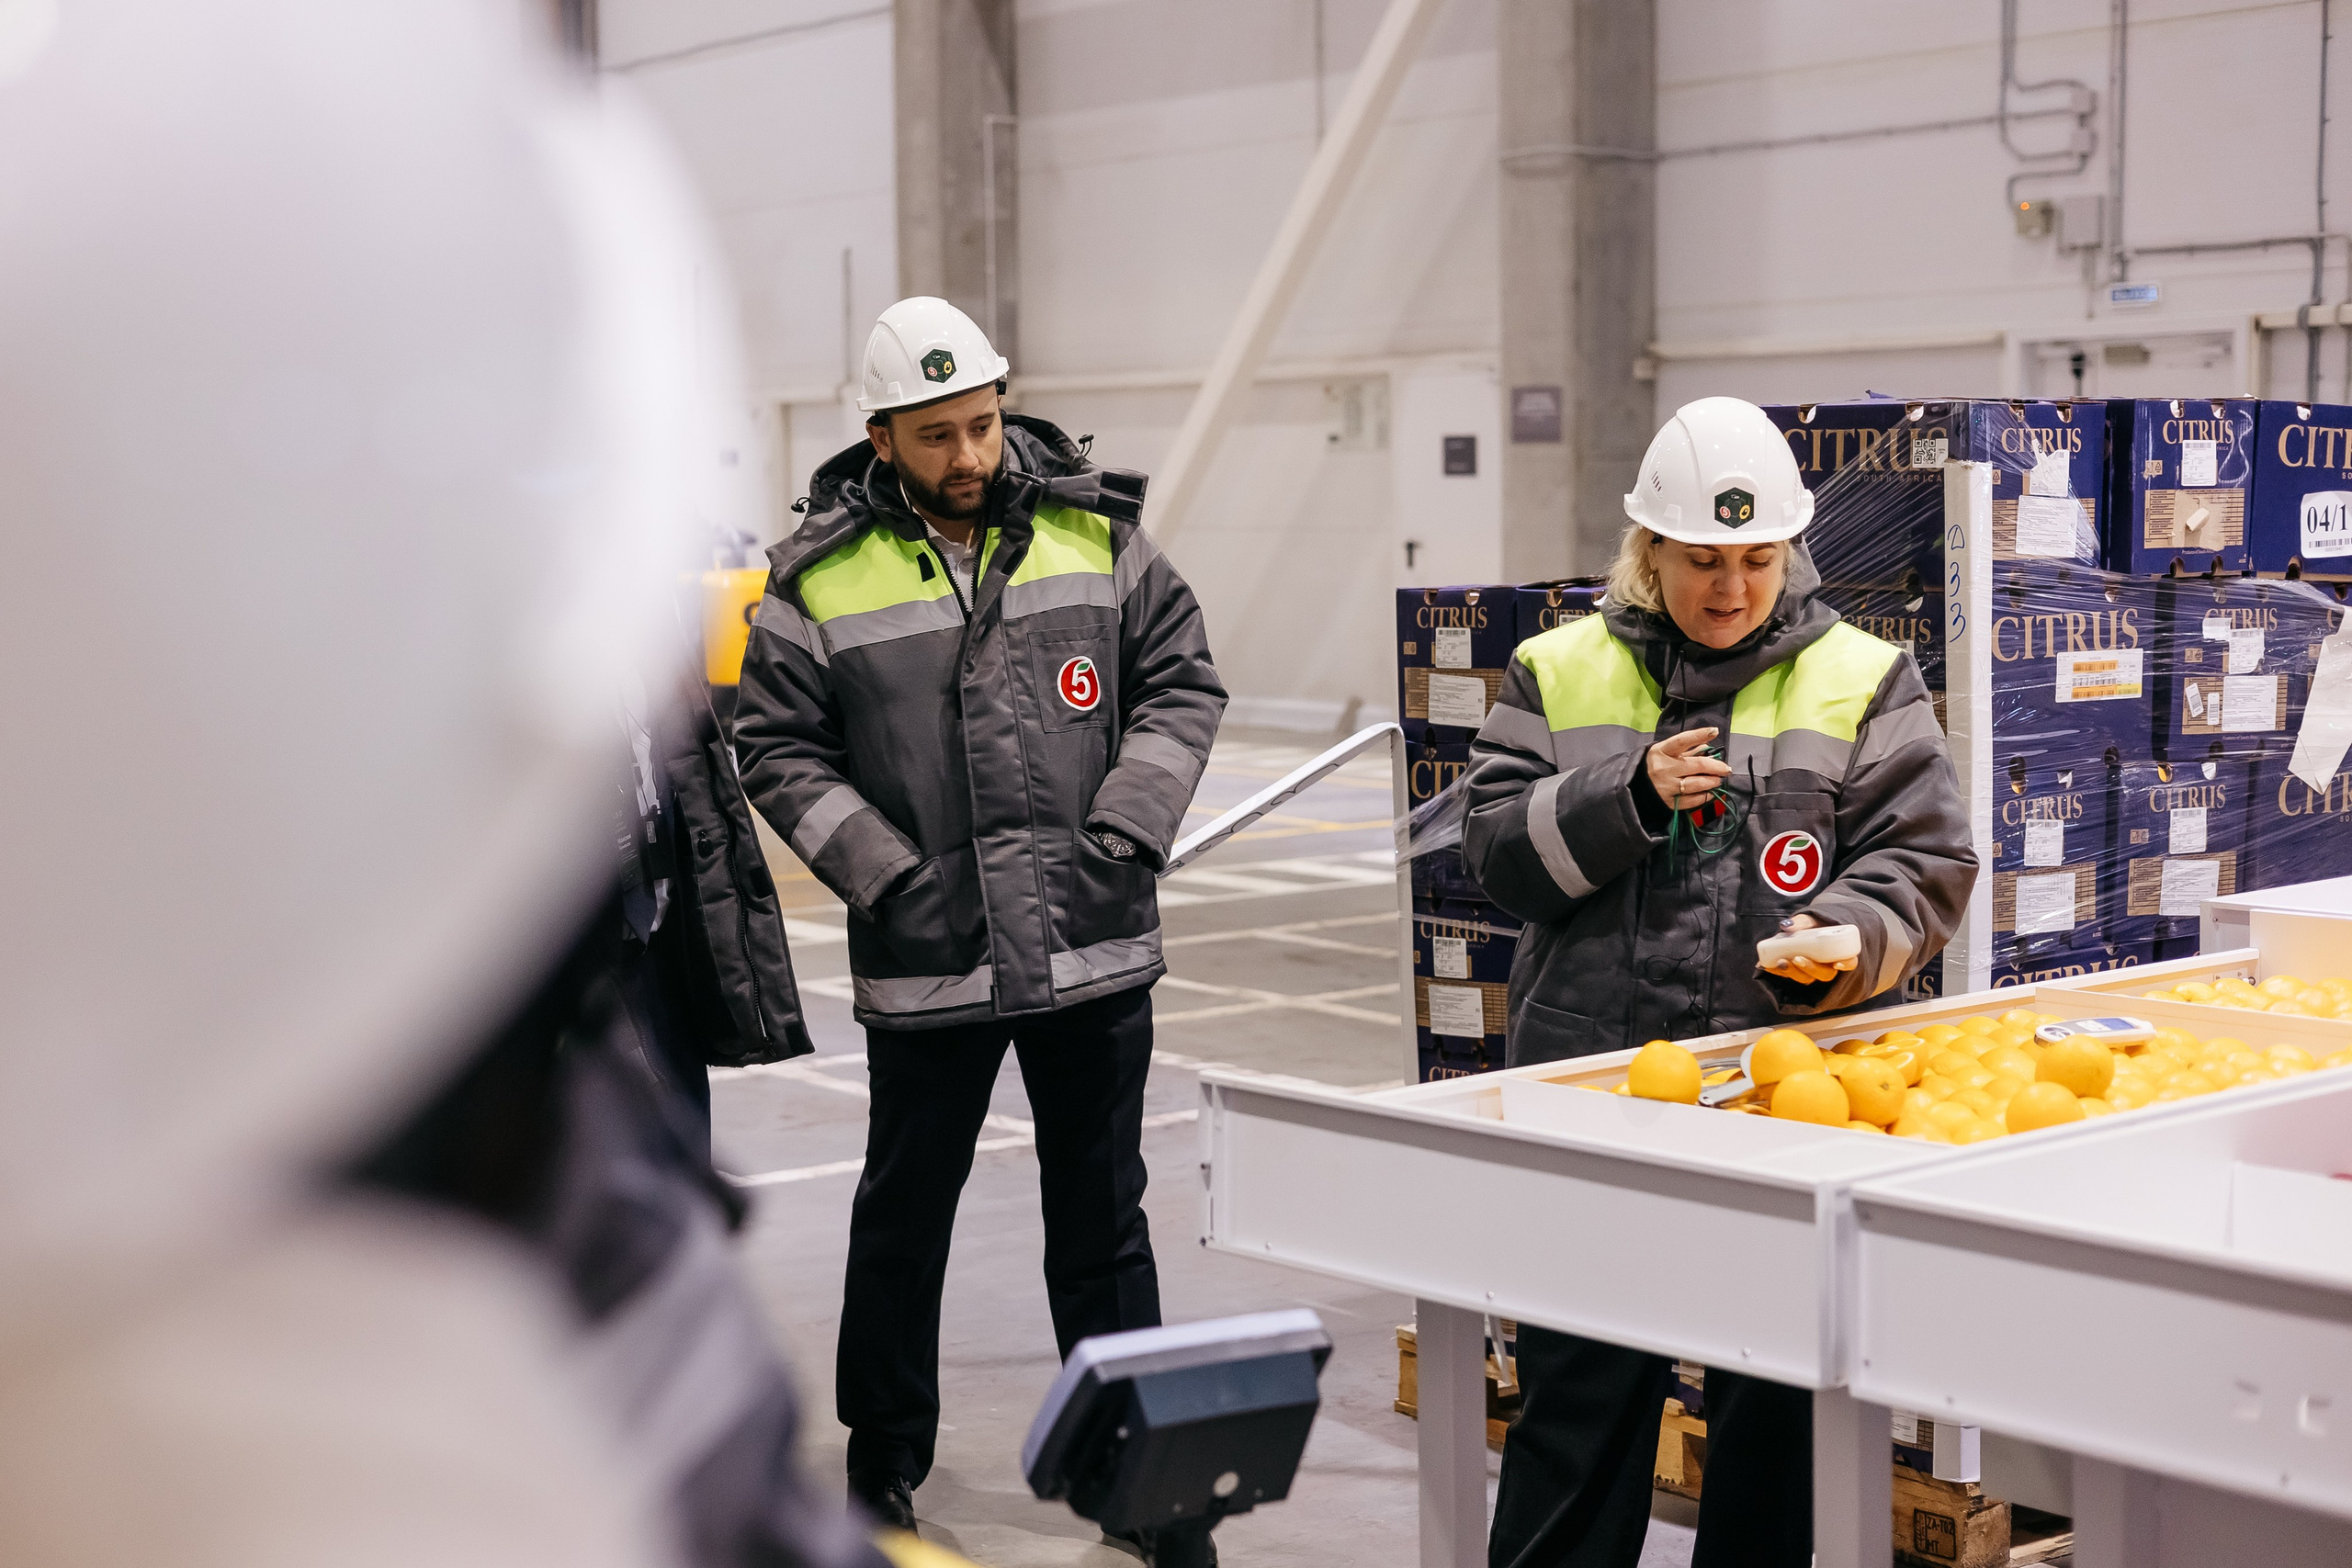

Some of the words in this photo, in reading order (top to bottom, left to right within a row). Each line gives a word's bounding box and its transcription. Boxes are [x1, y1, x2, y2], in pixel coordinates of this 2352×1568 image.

[2001, 427, 2083, 454] CITRUS
[2163, 420, 2235, 445] CITRUS
[1416, 606, 1487, 628] CITRUS
[1992, 607, 2139, 662] CITRUS
[1071, 660, 1091, 701] 5
[2002, 793, 2084, 826] CITRUS
[2150, 784, 2226, 813] CITRUS
[1777, 836, 1813, 885] 5
